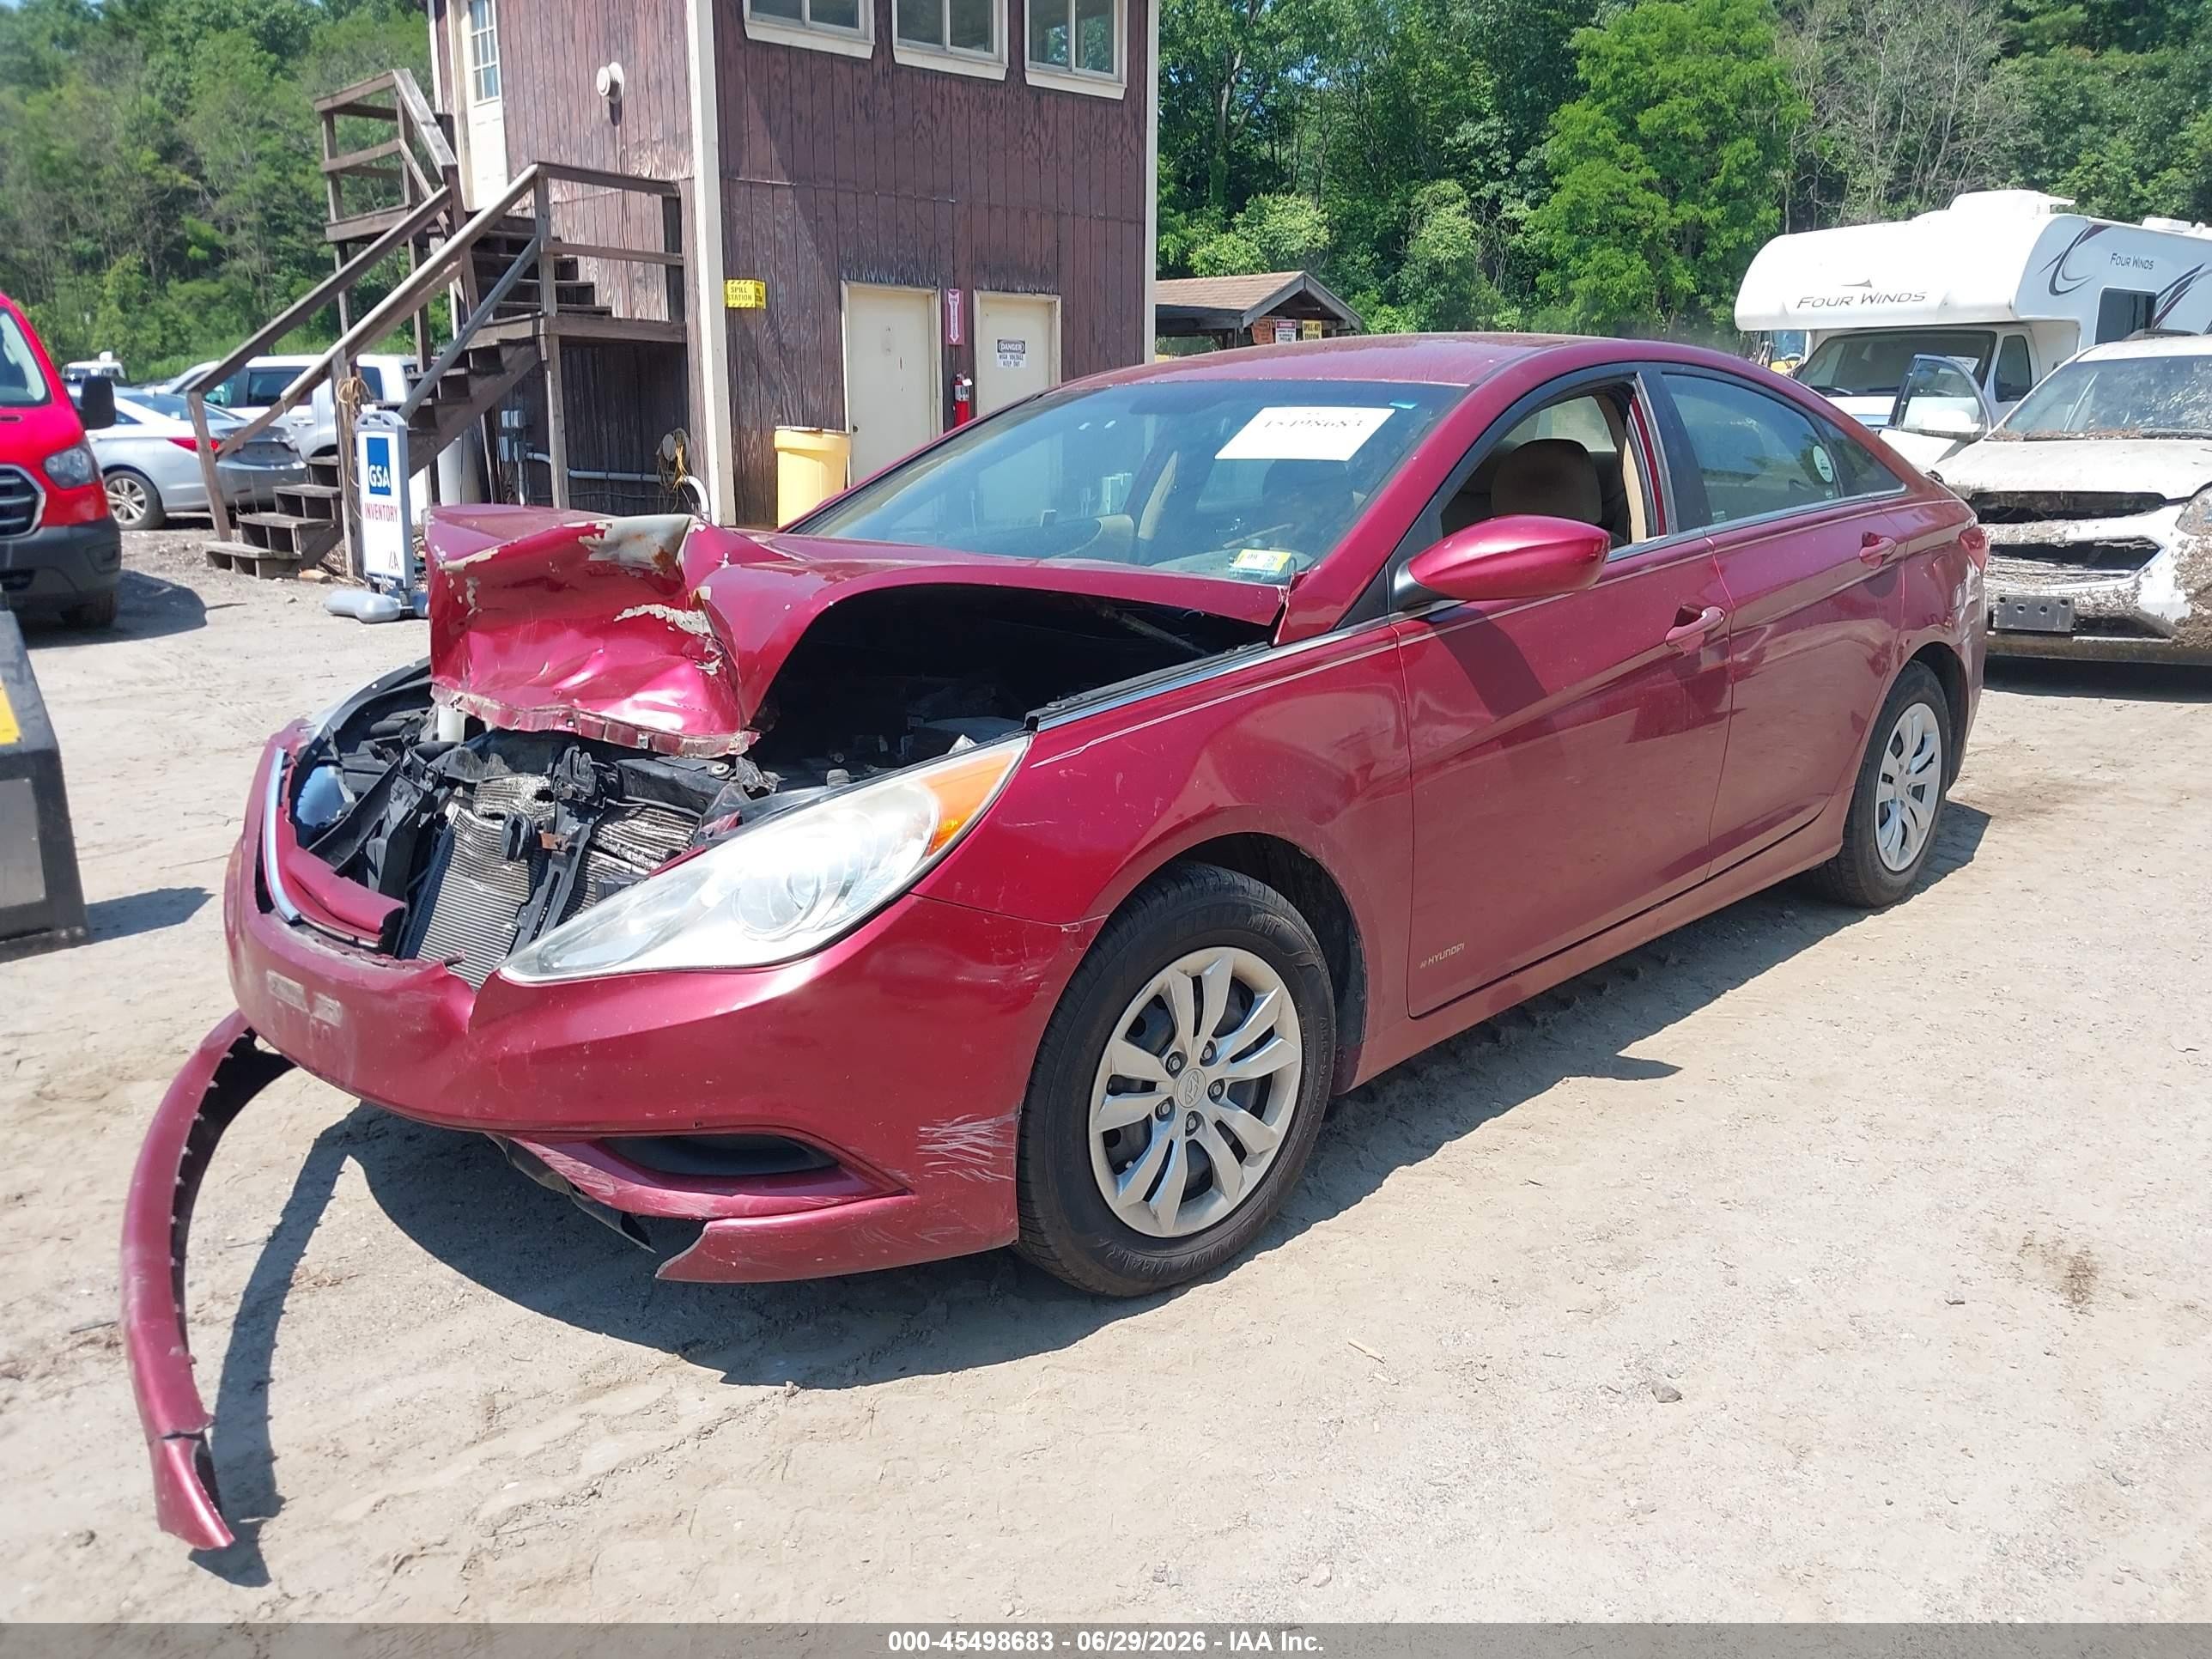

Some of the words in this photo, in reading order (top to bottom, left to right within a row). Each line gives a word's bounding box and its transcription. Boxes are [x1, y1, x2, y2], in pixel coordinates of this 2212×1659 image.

[2110, 252, 2130, 267] FOUR
[2131, 255, 2154, 270] WINDS
[1796, 295, 1854, 309] FOUR
[1860, 291, 1928, 305] WINDS
[1000, 343, 1023, 351] DANGER
[368, 464, 391, 489] GSA
[364, 501, 398, 523] INVENTORY
[1427, 942, 1465, 966] HYUNDAI
